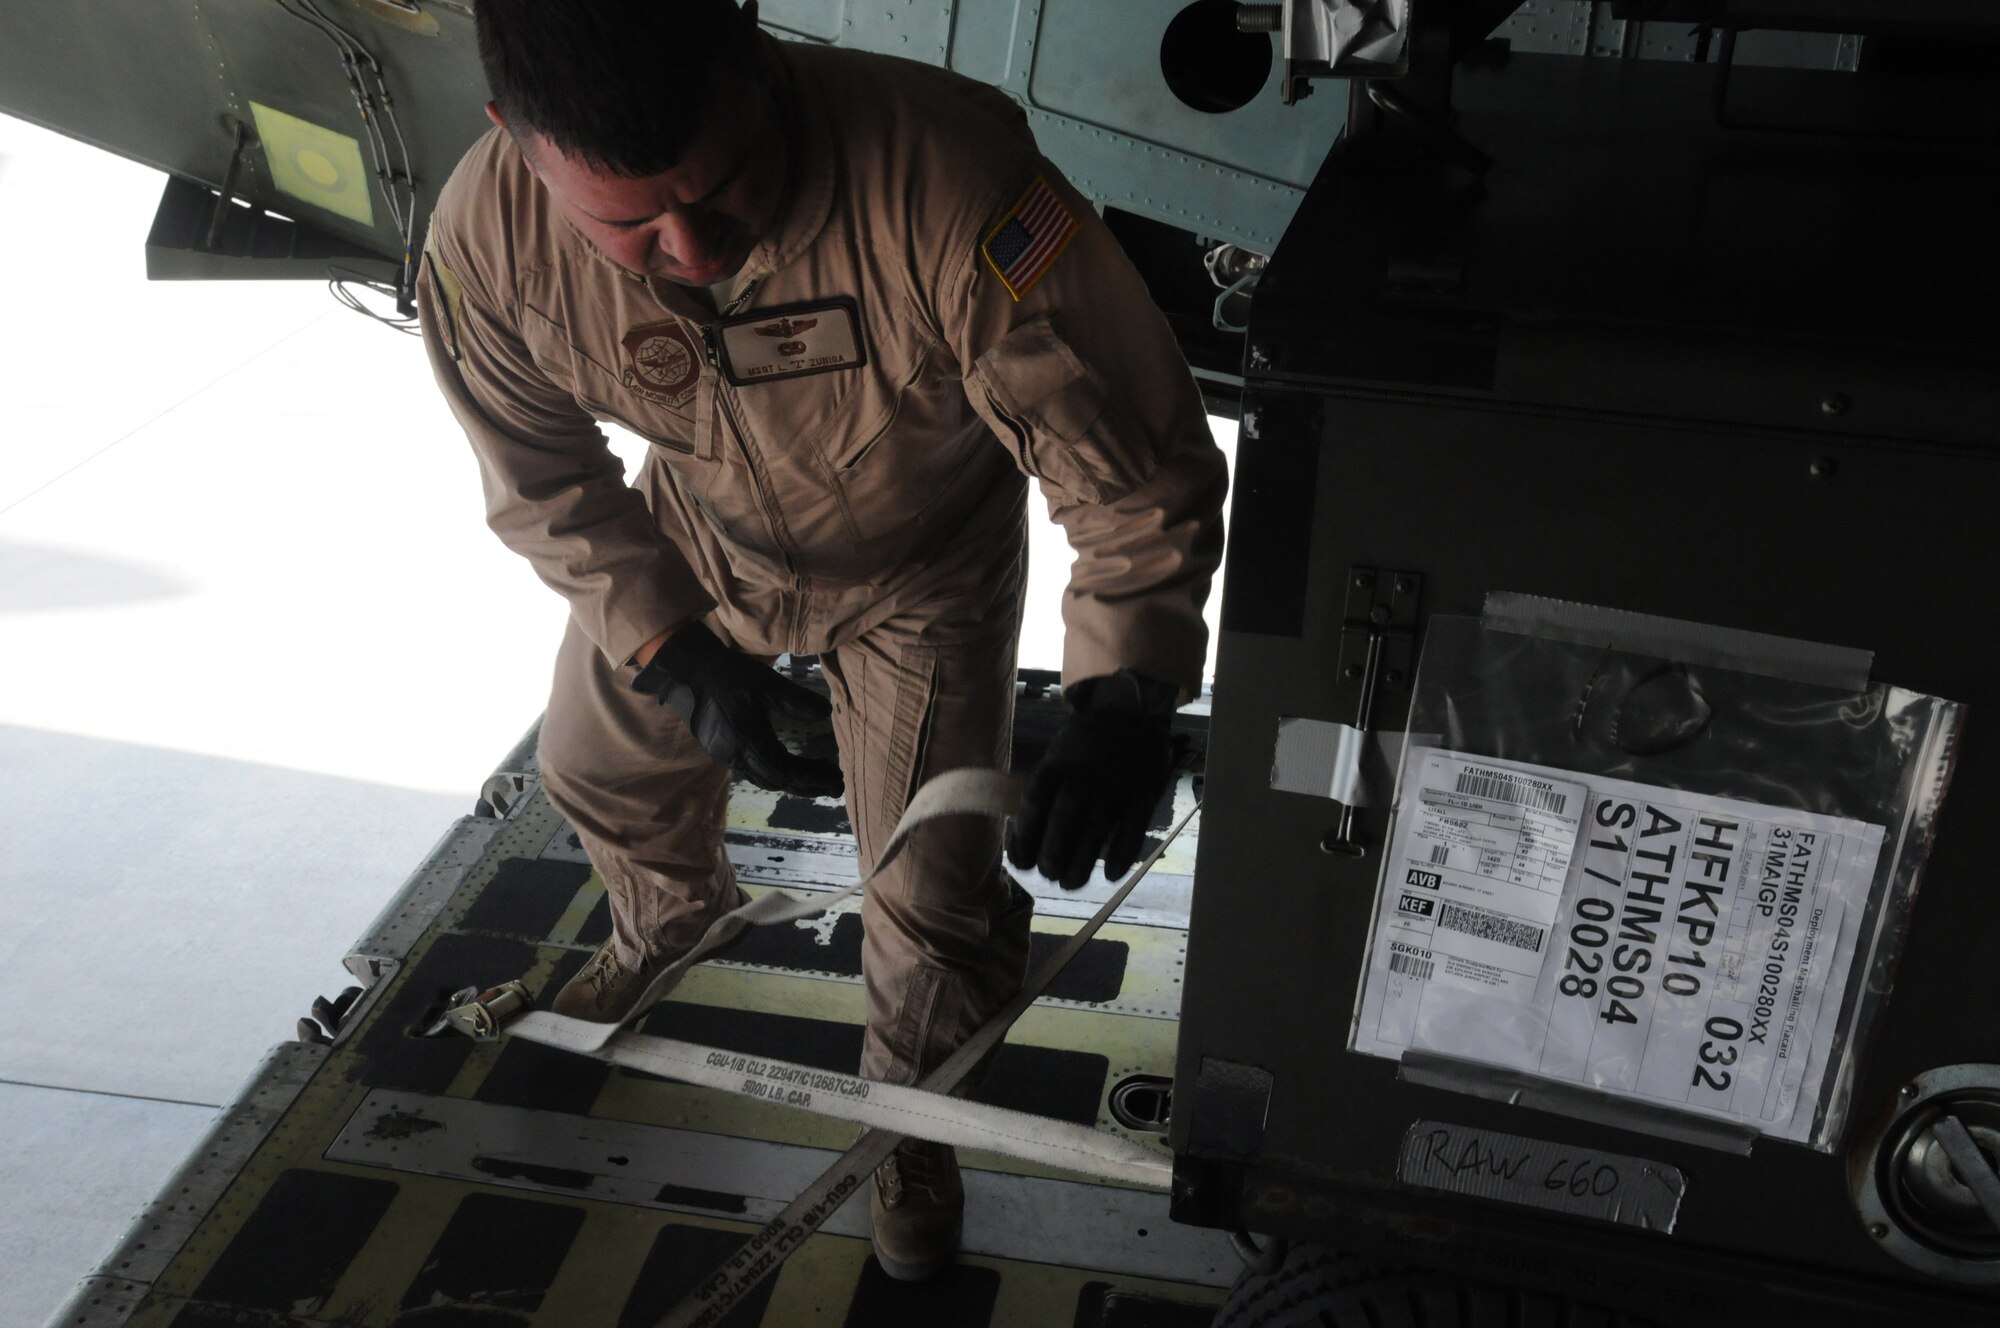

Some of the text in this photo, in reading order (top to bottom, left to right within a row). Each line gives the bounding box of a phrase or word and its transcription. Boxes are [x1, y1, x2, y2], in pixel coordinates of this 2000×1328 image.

[747, 365, 774, 376] MSGT
[810, 355, 845, 367] ZUNIGA
[1464, 766, 1553, 791] FATHMS04S100280XX
[1590, 799, 1636, 853] S1
[1407, 870, 1438, 889] AVB
[1756, 828, 1792, 917] 31MAIGP
[1400, 896, 1428, 913] KEF
[1600, 804, 1682, 1024] ATHMS04
[1662, 817, 1739, 997] HFKP10
[1390, 943, 1432, 960] SGK010
[1559, 897, 1615, 999] 0028
[1748, 832, 1816, 1045] FATHMS04S100280XX
[1801, 908, 1823, 965] Deployment
[706, 1052, 747, 1071] CGU-1/B
[746, 1061, 768, 1076] CL2
[1692, 1016, 1744, 1091] 032
[741, 1079, 768, 1097] 5000
[1424, 1129, 1619, 1197] RAW 660
[802, 1174, 857, 1227] CGU-1/B
[751, 1218, 787, 1251] 5000
[773, 1226, 804, 1251] CL2
